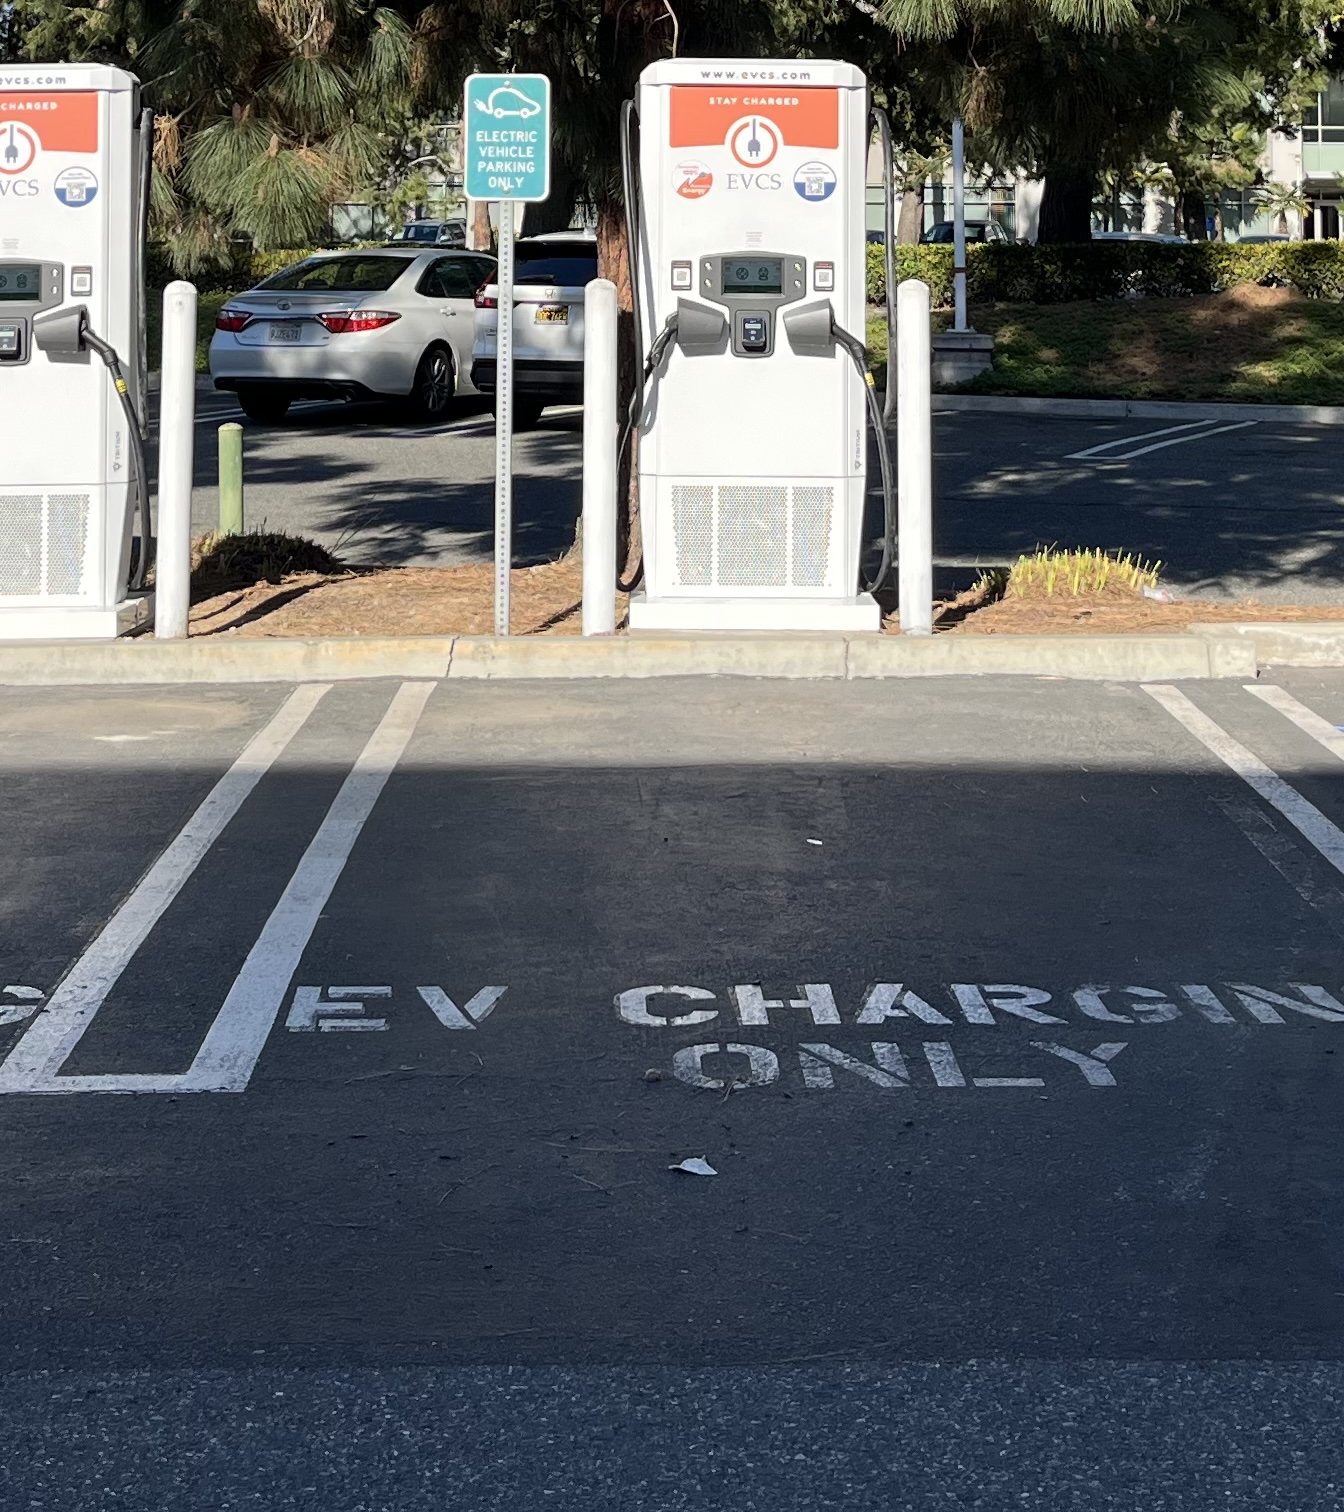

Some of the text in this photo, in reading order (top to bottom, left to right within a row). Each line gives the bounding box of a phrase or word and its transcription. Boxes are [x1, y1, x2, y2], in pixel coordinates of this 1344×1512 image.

[700, 70, 811, 80] www.evcs.com
[0, 102, 58, 111] CHARGED
[709, 97, 799, 106] STAY CHARGED
[476, 130, 537, 142] ELECTRIC
[479, 146, 534, 158] VEHICLE
[477, 161, 535, 173] PARKING
[488, 176, 524, 188] ONLY
[727, 173, 782, 190] EVCS
[285, 985, 509, 1032] EV
[673, 1041, 1129, 1089] ONLY
